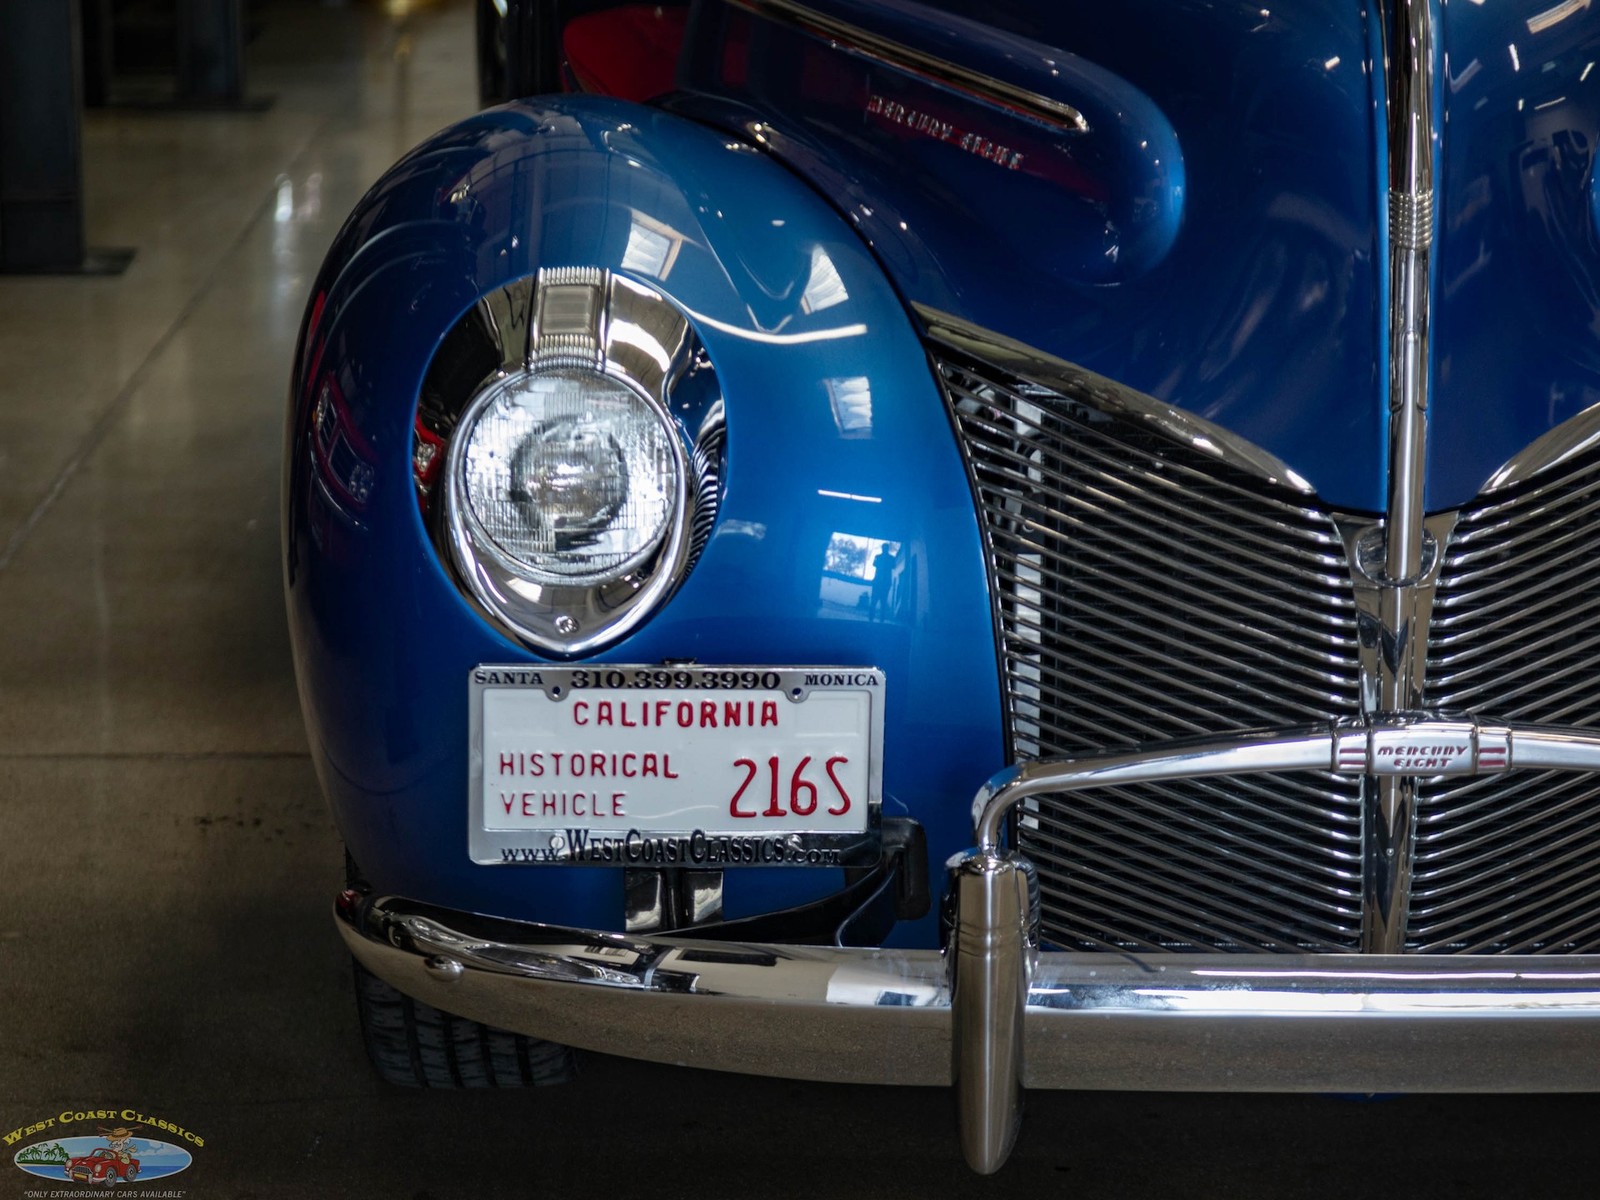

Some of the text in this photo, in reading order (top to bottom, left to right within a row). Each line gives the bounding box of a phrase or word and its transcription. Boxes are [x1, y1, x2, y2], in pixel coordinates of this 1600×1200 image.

[474, 671, 879, 689] SANTA 310.399.3990 MONICA
[573, 700, 779, 728] CALIFORNIA
[1377, 745, 1468, 756] MERCURY
[1393, 758, 1452, 768] EIGHT
[500, 752, 679, 779] HISTORICAL
[729, 756, 851, 818] 216S
[500, 792, 626, 817] VEHICLE
